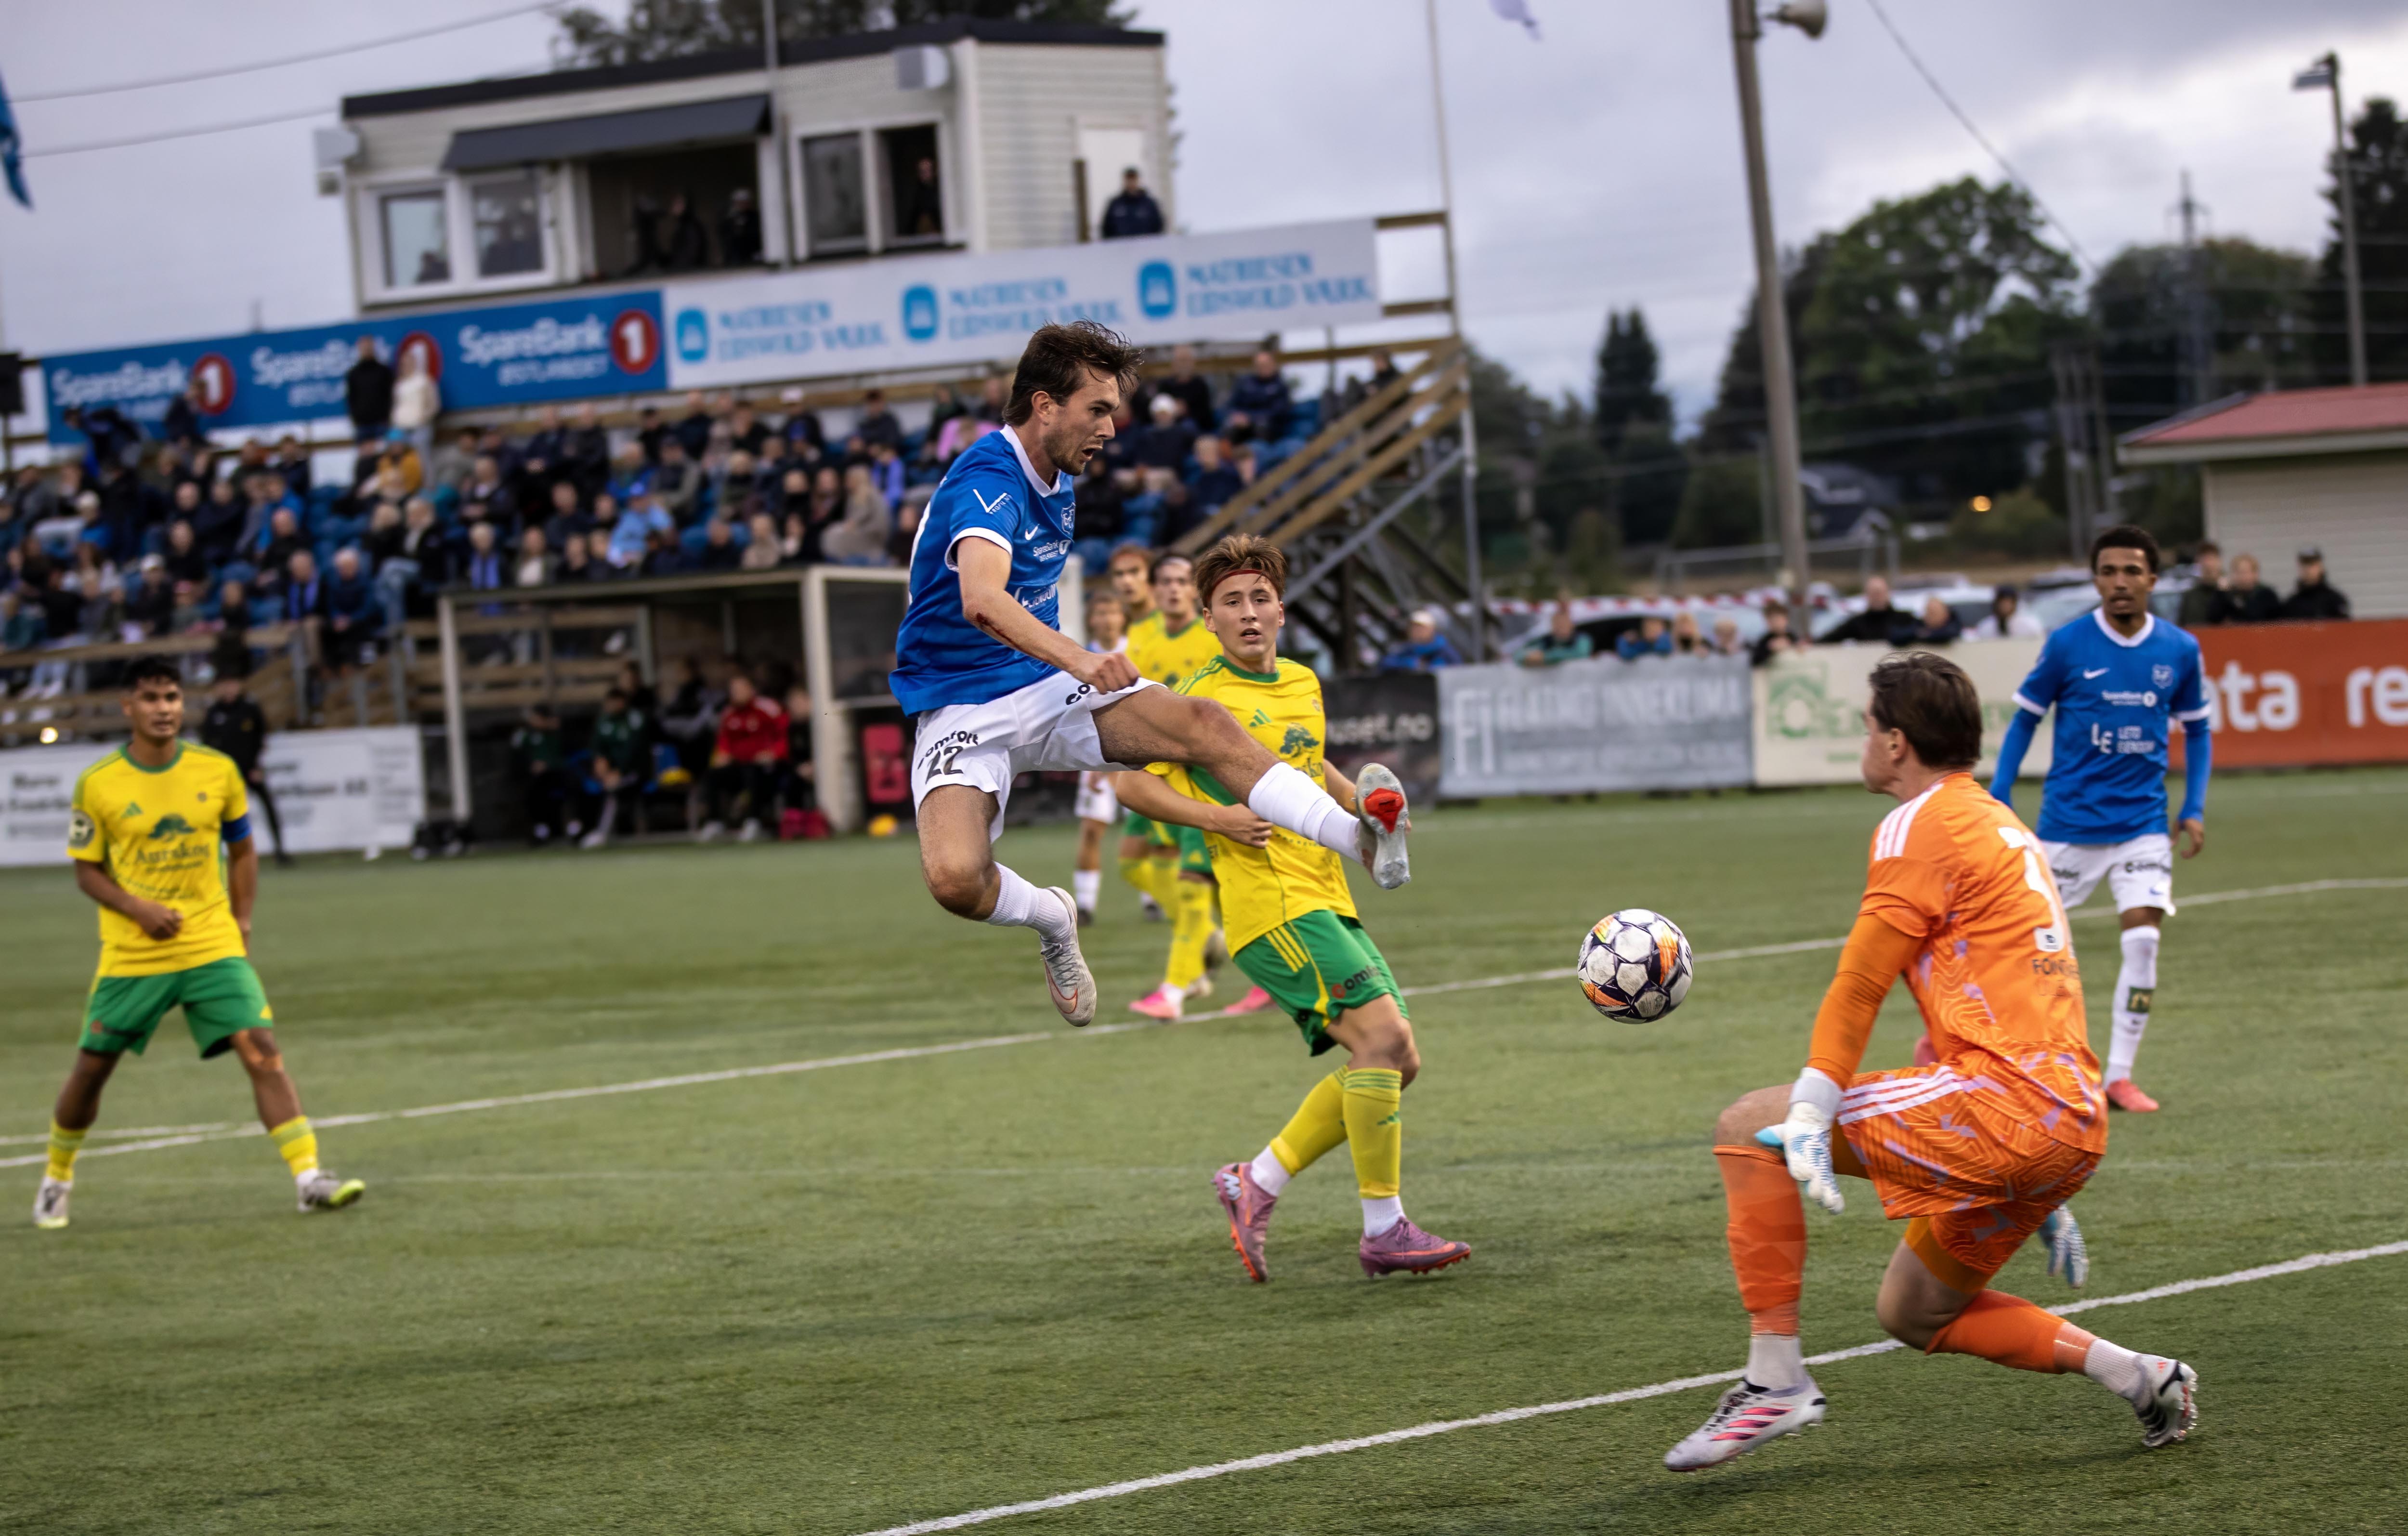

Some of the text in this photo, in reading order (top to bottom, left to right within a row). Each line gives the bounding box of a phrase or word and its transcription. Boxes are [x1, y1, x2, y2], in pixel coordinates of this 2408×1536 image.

[458, 313, 644, 368] SpareBank 1
[200, 361, 224, 406] 1
